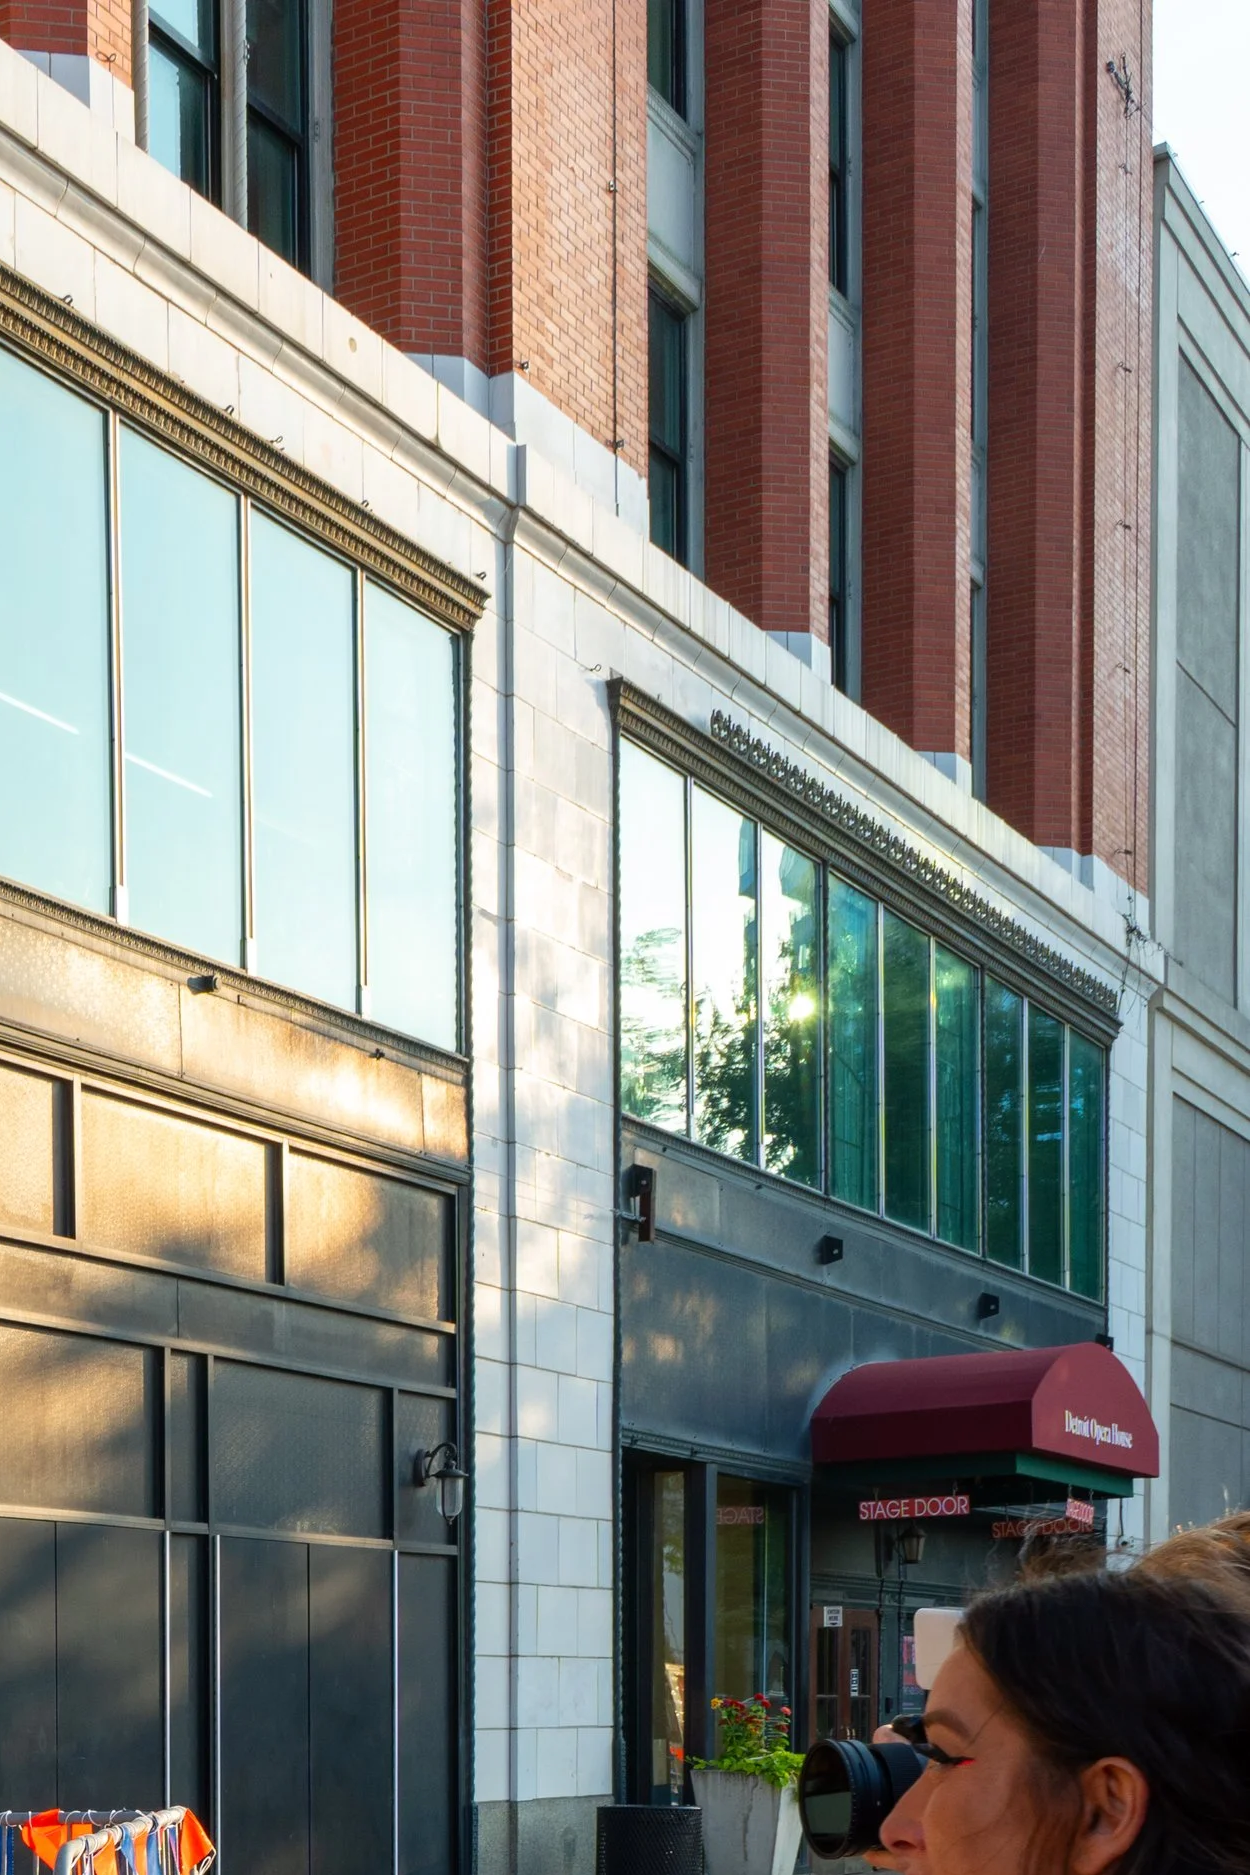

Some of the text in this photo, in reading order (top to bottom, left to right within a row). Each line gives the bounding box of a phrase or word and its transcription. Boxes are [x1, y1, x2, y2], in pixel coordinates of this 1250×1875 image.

[1065, 1410, 1134, 1448] Detroit Opera House
[859, 1496, 970, 1520] STAGE DOOR
